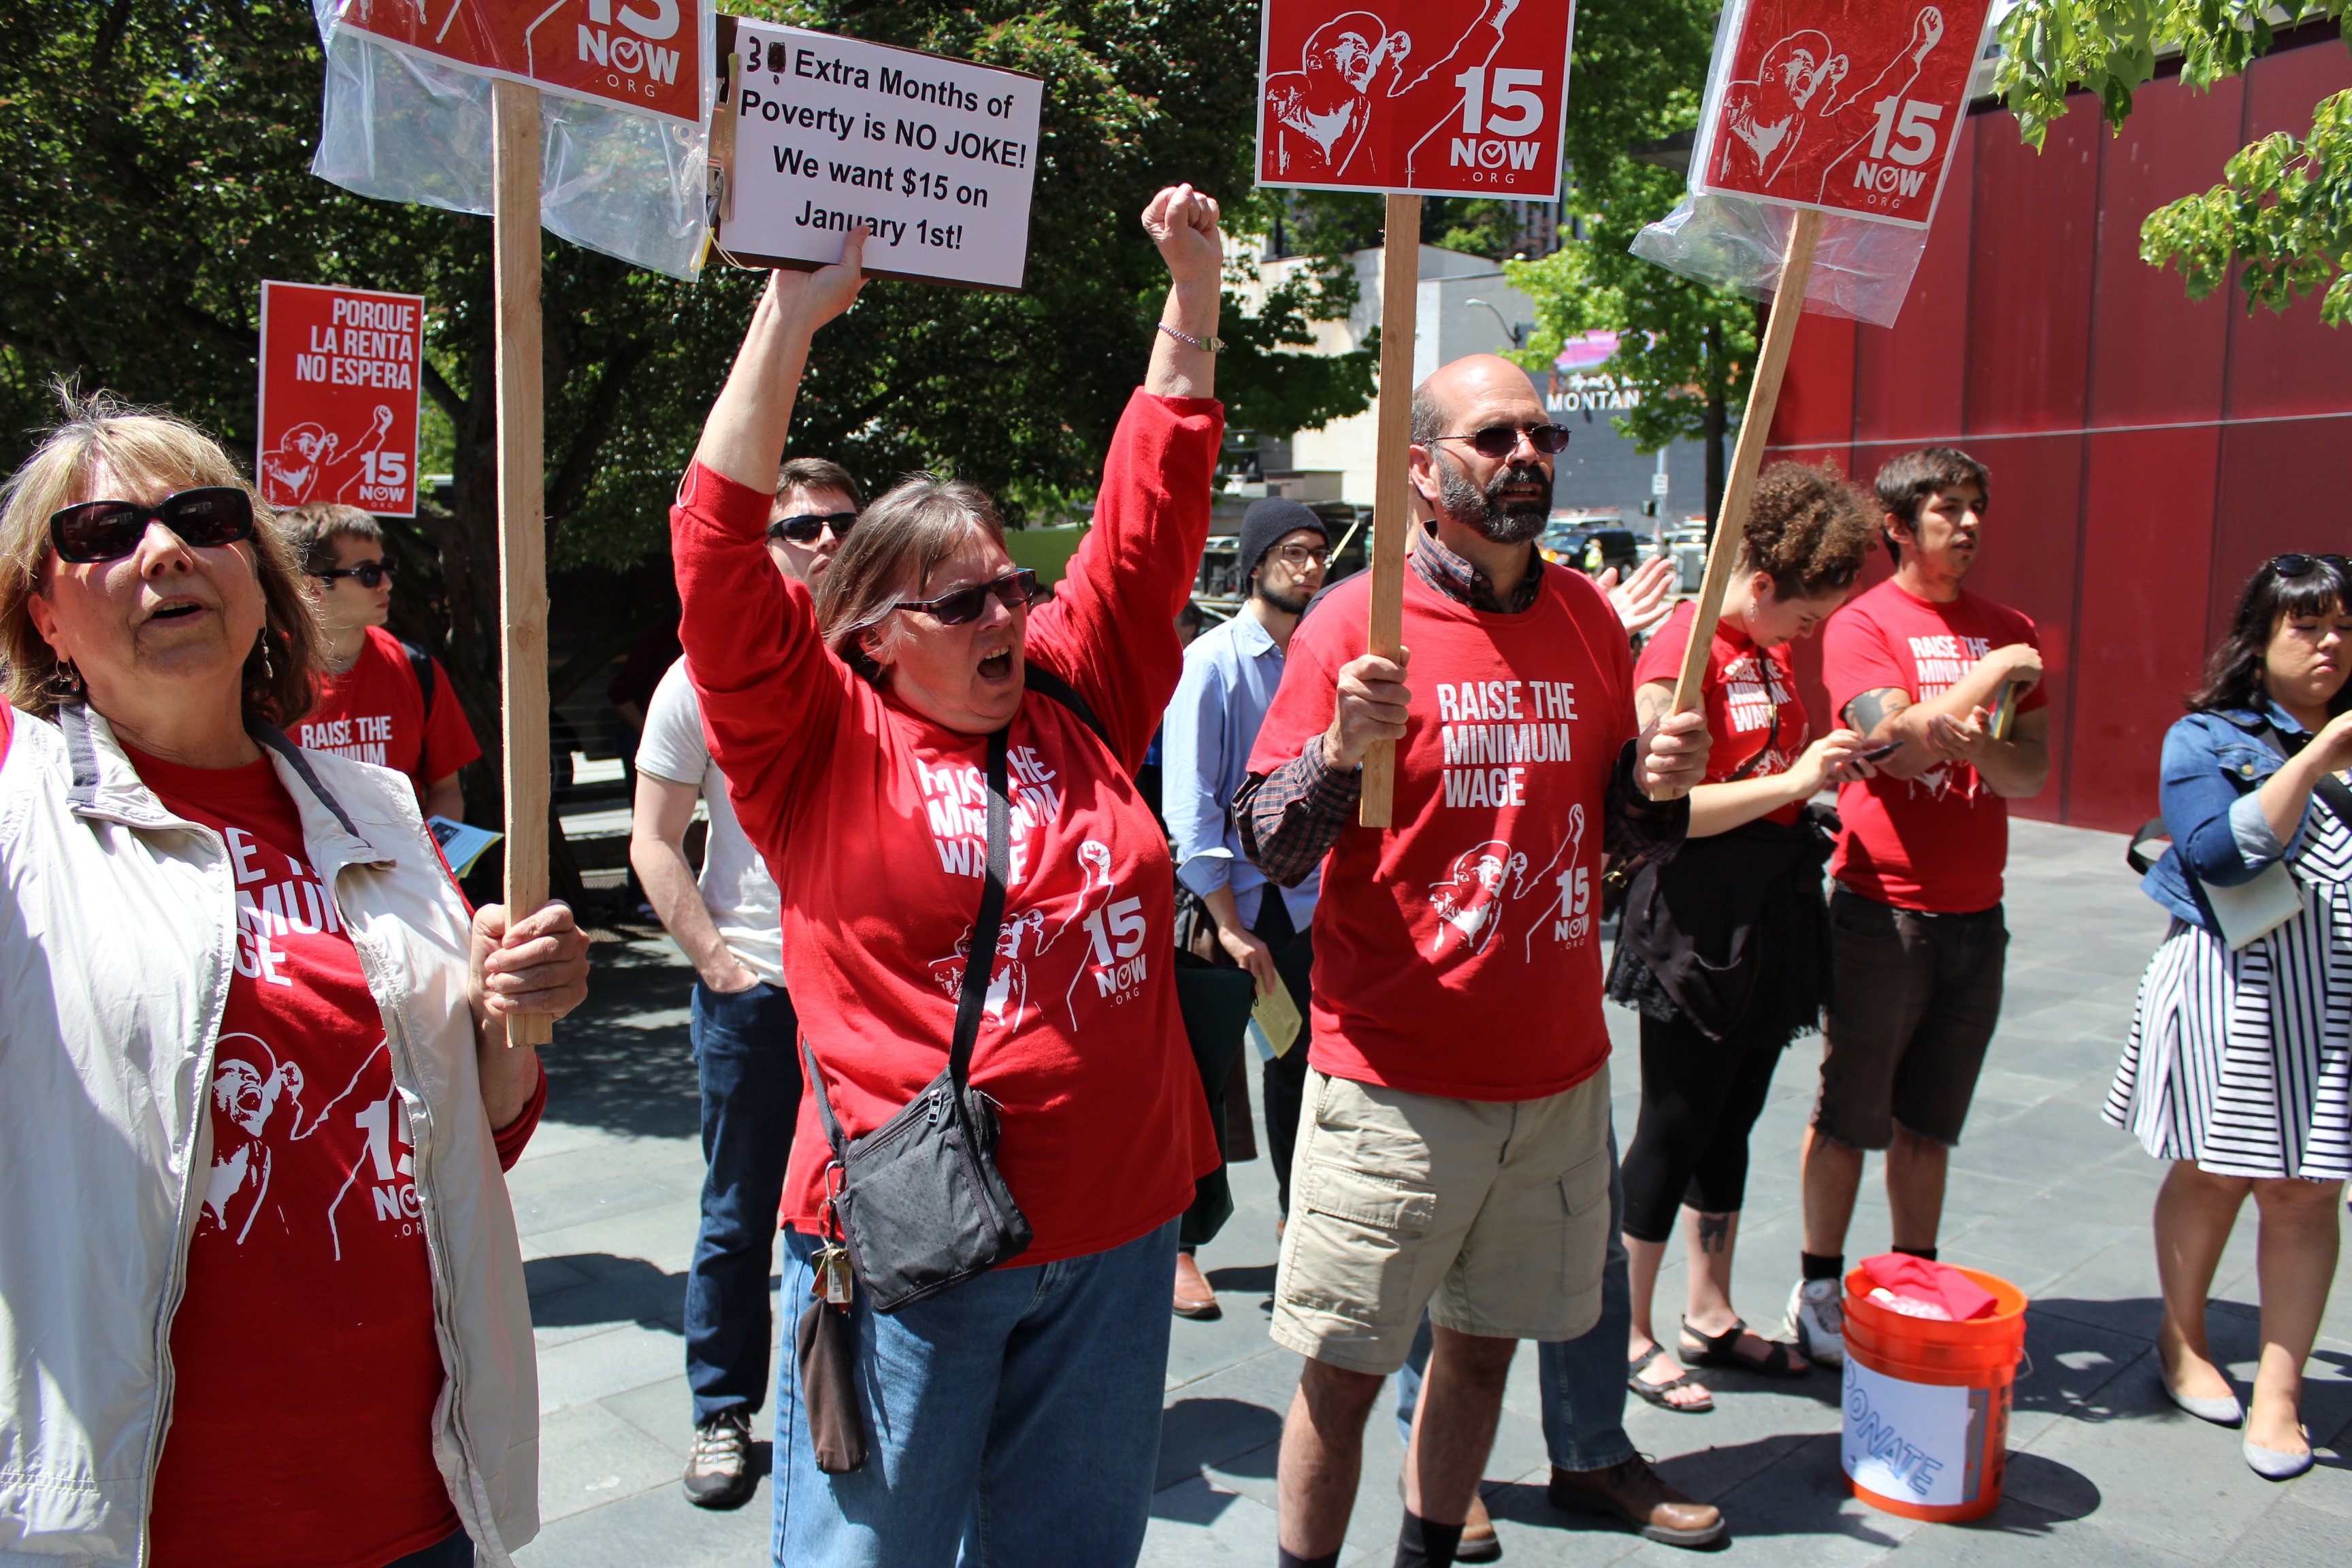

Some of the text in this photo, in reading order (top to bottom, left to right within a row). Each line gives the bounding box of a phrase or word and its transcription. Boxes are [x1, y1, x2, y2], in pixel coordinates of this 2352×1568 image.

[577, 23, 680, 85] NOW
[795, 49, 869, 90] Extra
[879, 67, 978, 112] Months
[987, 95, 1013, 119] of
[1455, 66, 1544, 137] 15
[740, 89, 854, 141] Poverty
[864, 113, 885, 141] is
[895, 119, 937, 150] NO
[945, 131, 1027, 169] JOKE!
[1869, 95, 1943, 165] 15
[1450, 137, 1541, 171] NOW
[773, 145, 987, 208] We want $15 on
[1853, 161, 1927, 197] NOW
[796, 200, 962, 250] January 1st!
[333, 297, 415, 333] PORQUE
[310, 325, 414, 361] LA RENTA
[296, 353, 412, 390] NO ESPERA
[1546, 389, 1640, 412] MONTAN
[360, 451, 408, 486] 15
[359, 485, 406, 503] NOW
[1908, 635, 1961, 659] RAISE
[1437, 681, 1578, 722] RAISE THE
[301, 716, 393, 749] RAISE THE
[1441, 723, 1571, 765] MINIMUM
[1006, 745, 1057, 788] HE
[1443, 767, 1526, 808] WAGE
[934, 837, 1028, 885] WAE
[1556, 866, 1590, 917] 15
[1082, 896, 1146, 967] 15
[1554, 913, 1590, 942] NOW
[234, 928, 292, 987] GE
[1094, 953, 1147, 998] NOW
[372, 1183, 421, 1222] NO
